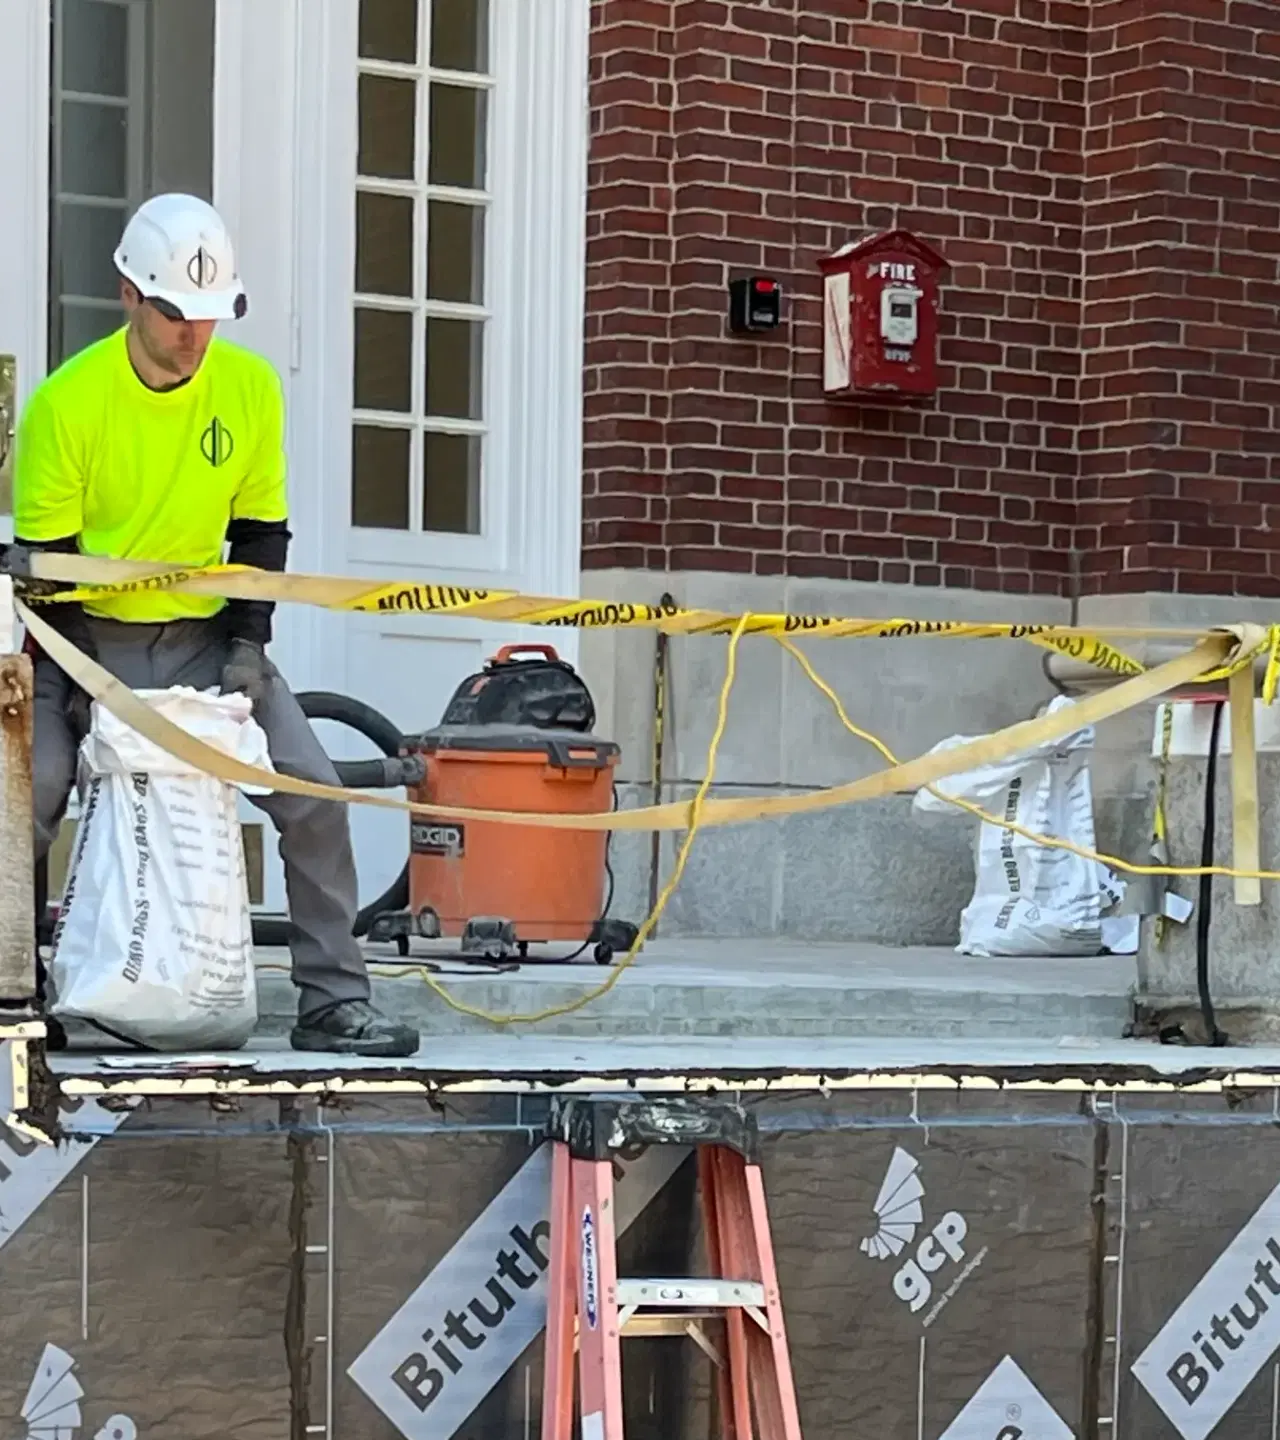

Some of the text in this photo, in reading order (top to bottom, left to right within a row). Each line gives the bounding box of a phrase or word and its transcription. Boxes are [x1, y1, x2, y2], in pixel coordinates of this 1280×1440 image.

[880, 262, 916, 281] FIRE
[892, 1211, 968, 1312] gcp
[390, 1219, 552, 1413] Bituth
